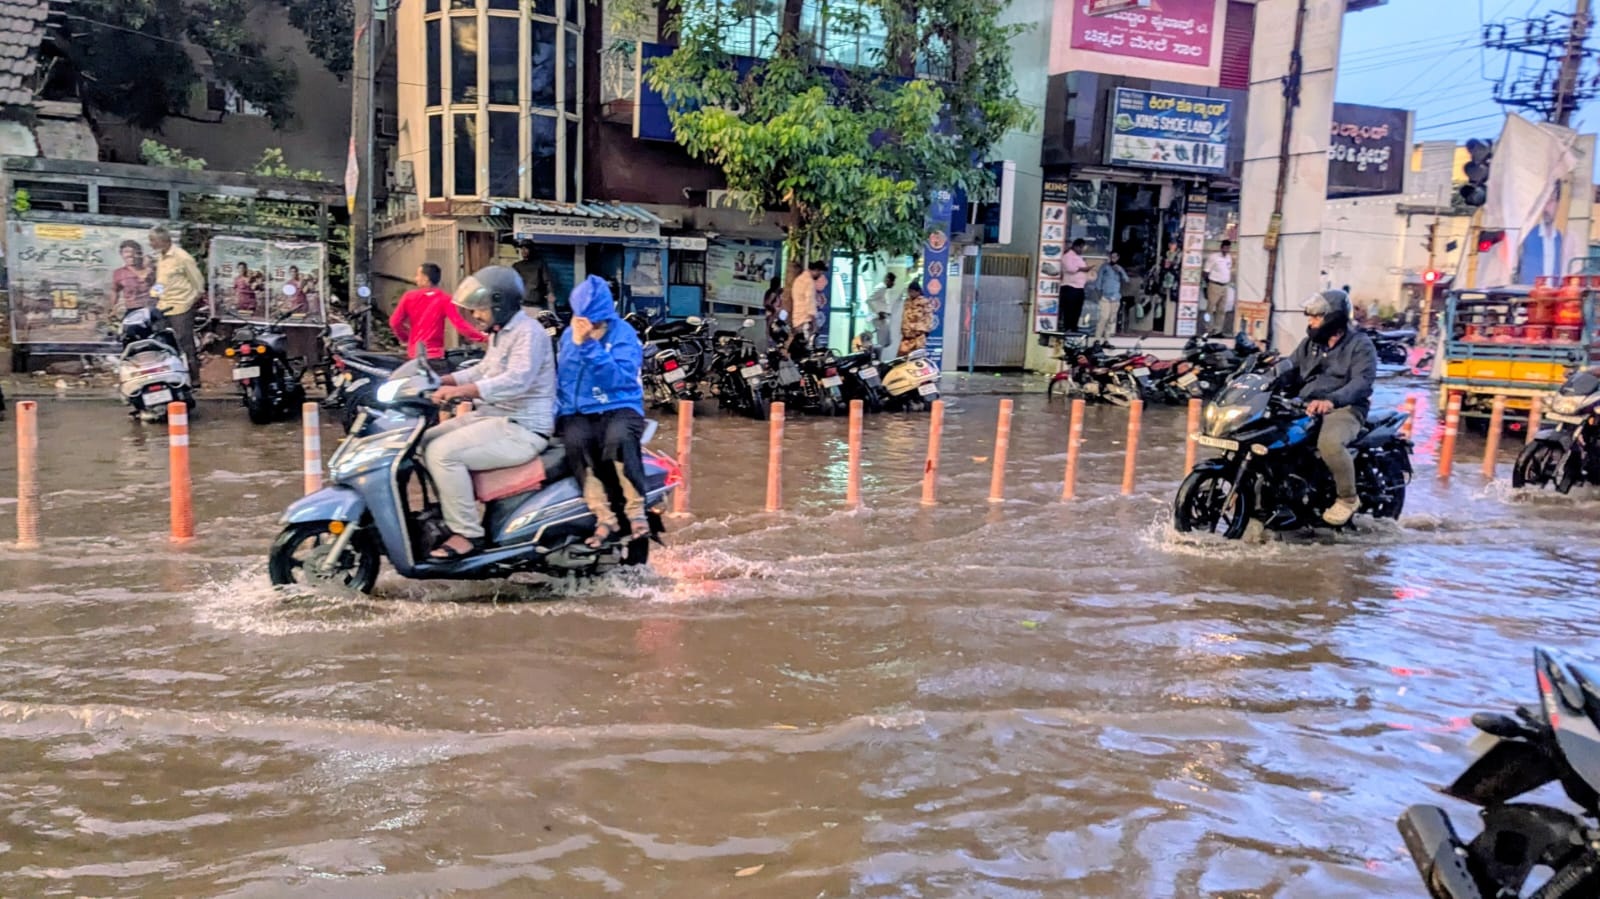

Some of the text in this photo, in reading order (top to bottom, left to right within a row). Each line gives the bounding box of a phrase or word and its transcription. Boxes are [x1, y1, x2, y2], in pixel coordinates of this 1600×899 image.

[1084, 29, 1124, 48] ಚಿನ್ನದ
[1130, 35, 1168, 52] ಮೇಲೆ
[1172, 43, 1203, 57] ಸಾಲ
[1135, 114, 1213, 134] KING SHOE LAND
[1044, 182, 1068, 192] KING
[1188, 194, 1207, 203] KING
[51, 289, 78, 309] 15
